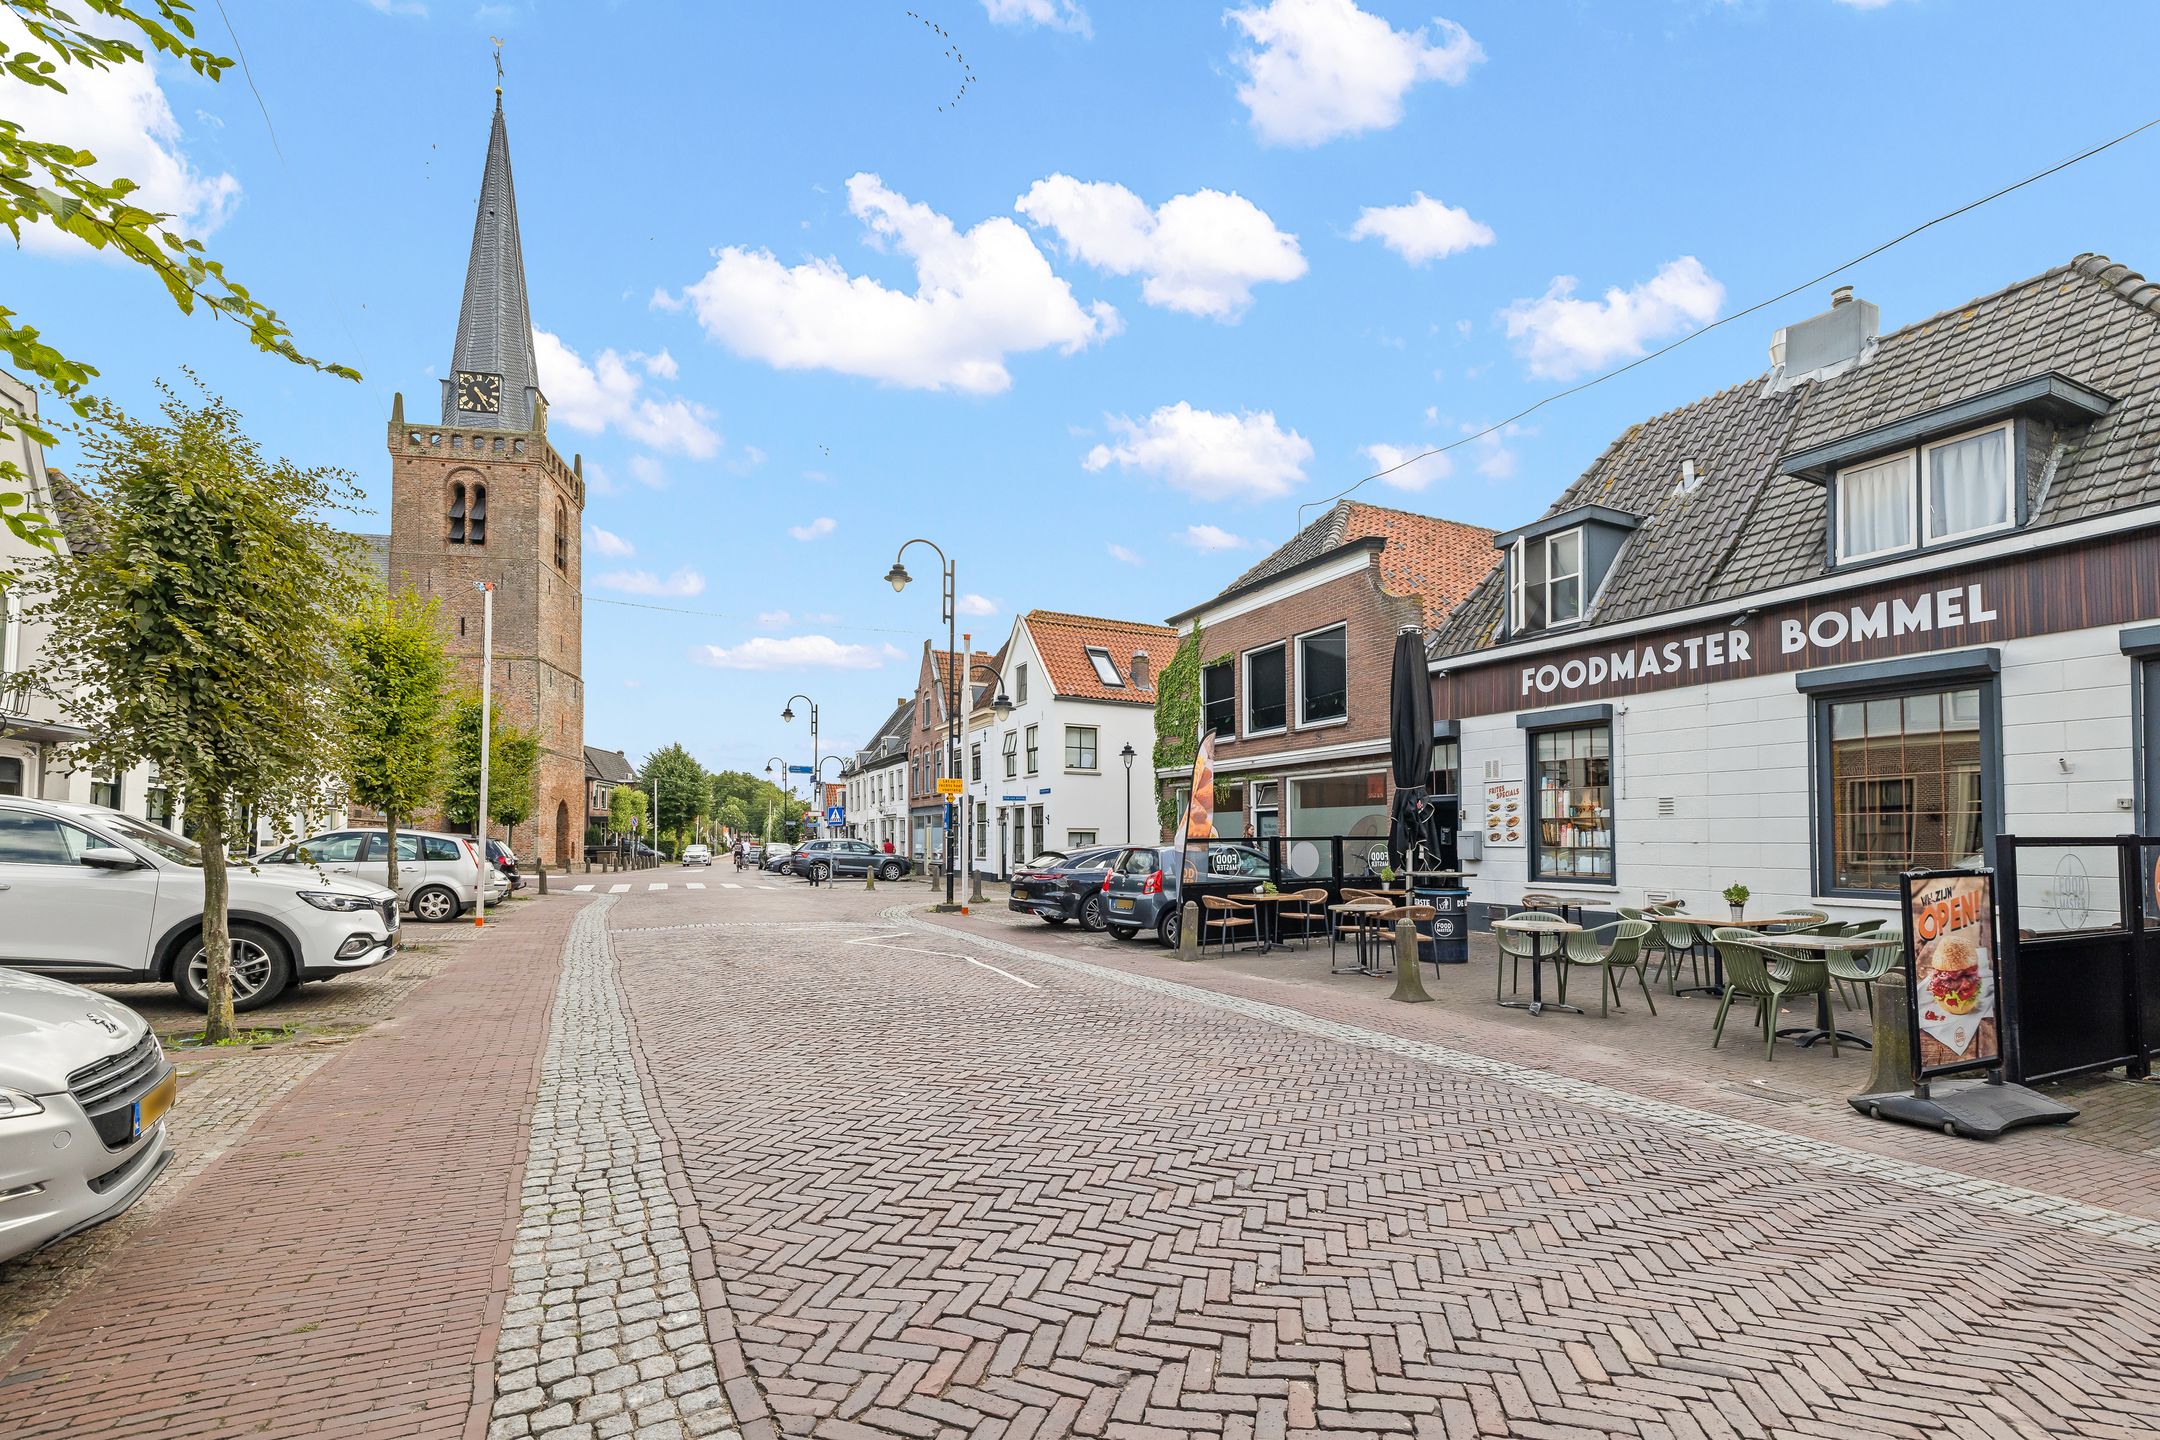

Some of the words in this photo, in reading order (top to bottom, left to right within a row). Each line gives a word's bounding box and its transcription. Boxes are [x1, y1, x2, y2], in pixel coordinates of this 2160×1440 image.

[1521, 629, 1752, 696] FOODMASTER
[1781, 583, 1998, 655] BOMMEL
[1488, 785, 1505, 795] FRITES
[1496, 788, 1520, 799] SPECIALS
[1935, 886, 1953, 902] ZIJN
[1919, 890, 1980, 941] OPEN!
